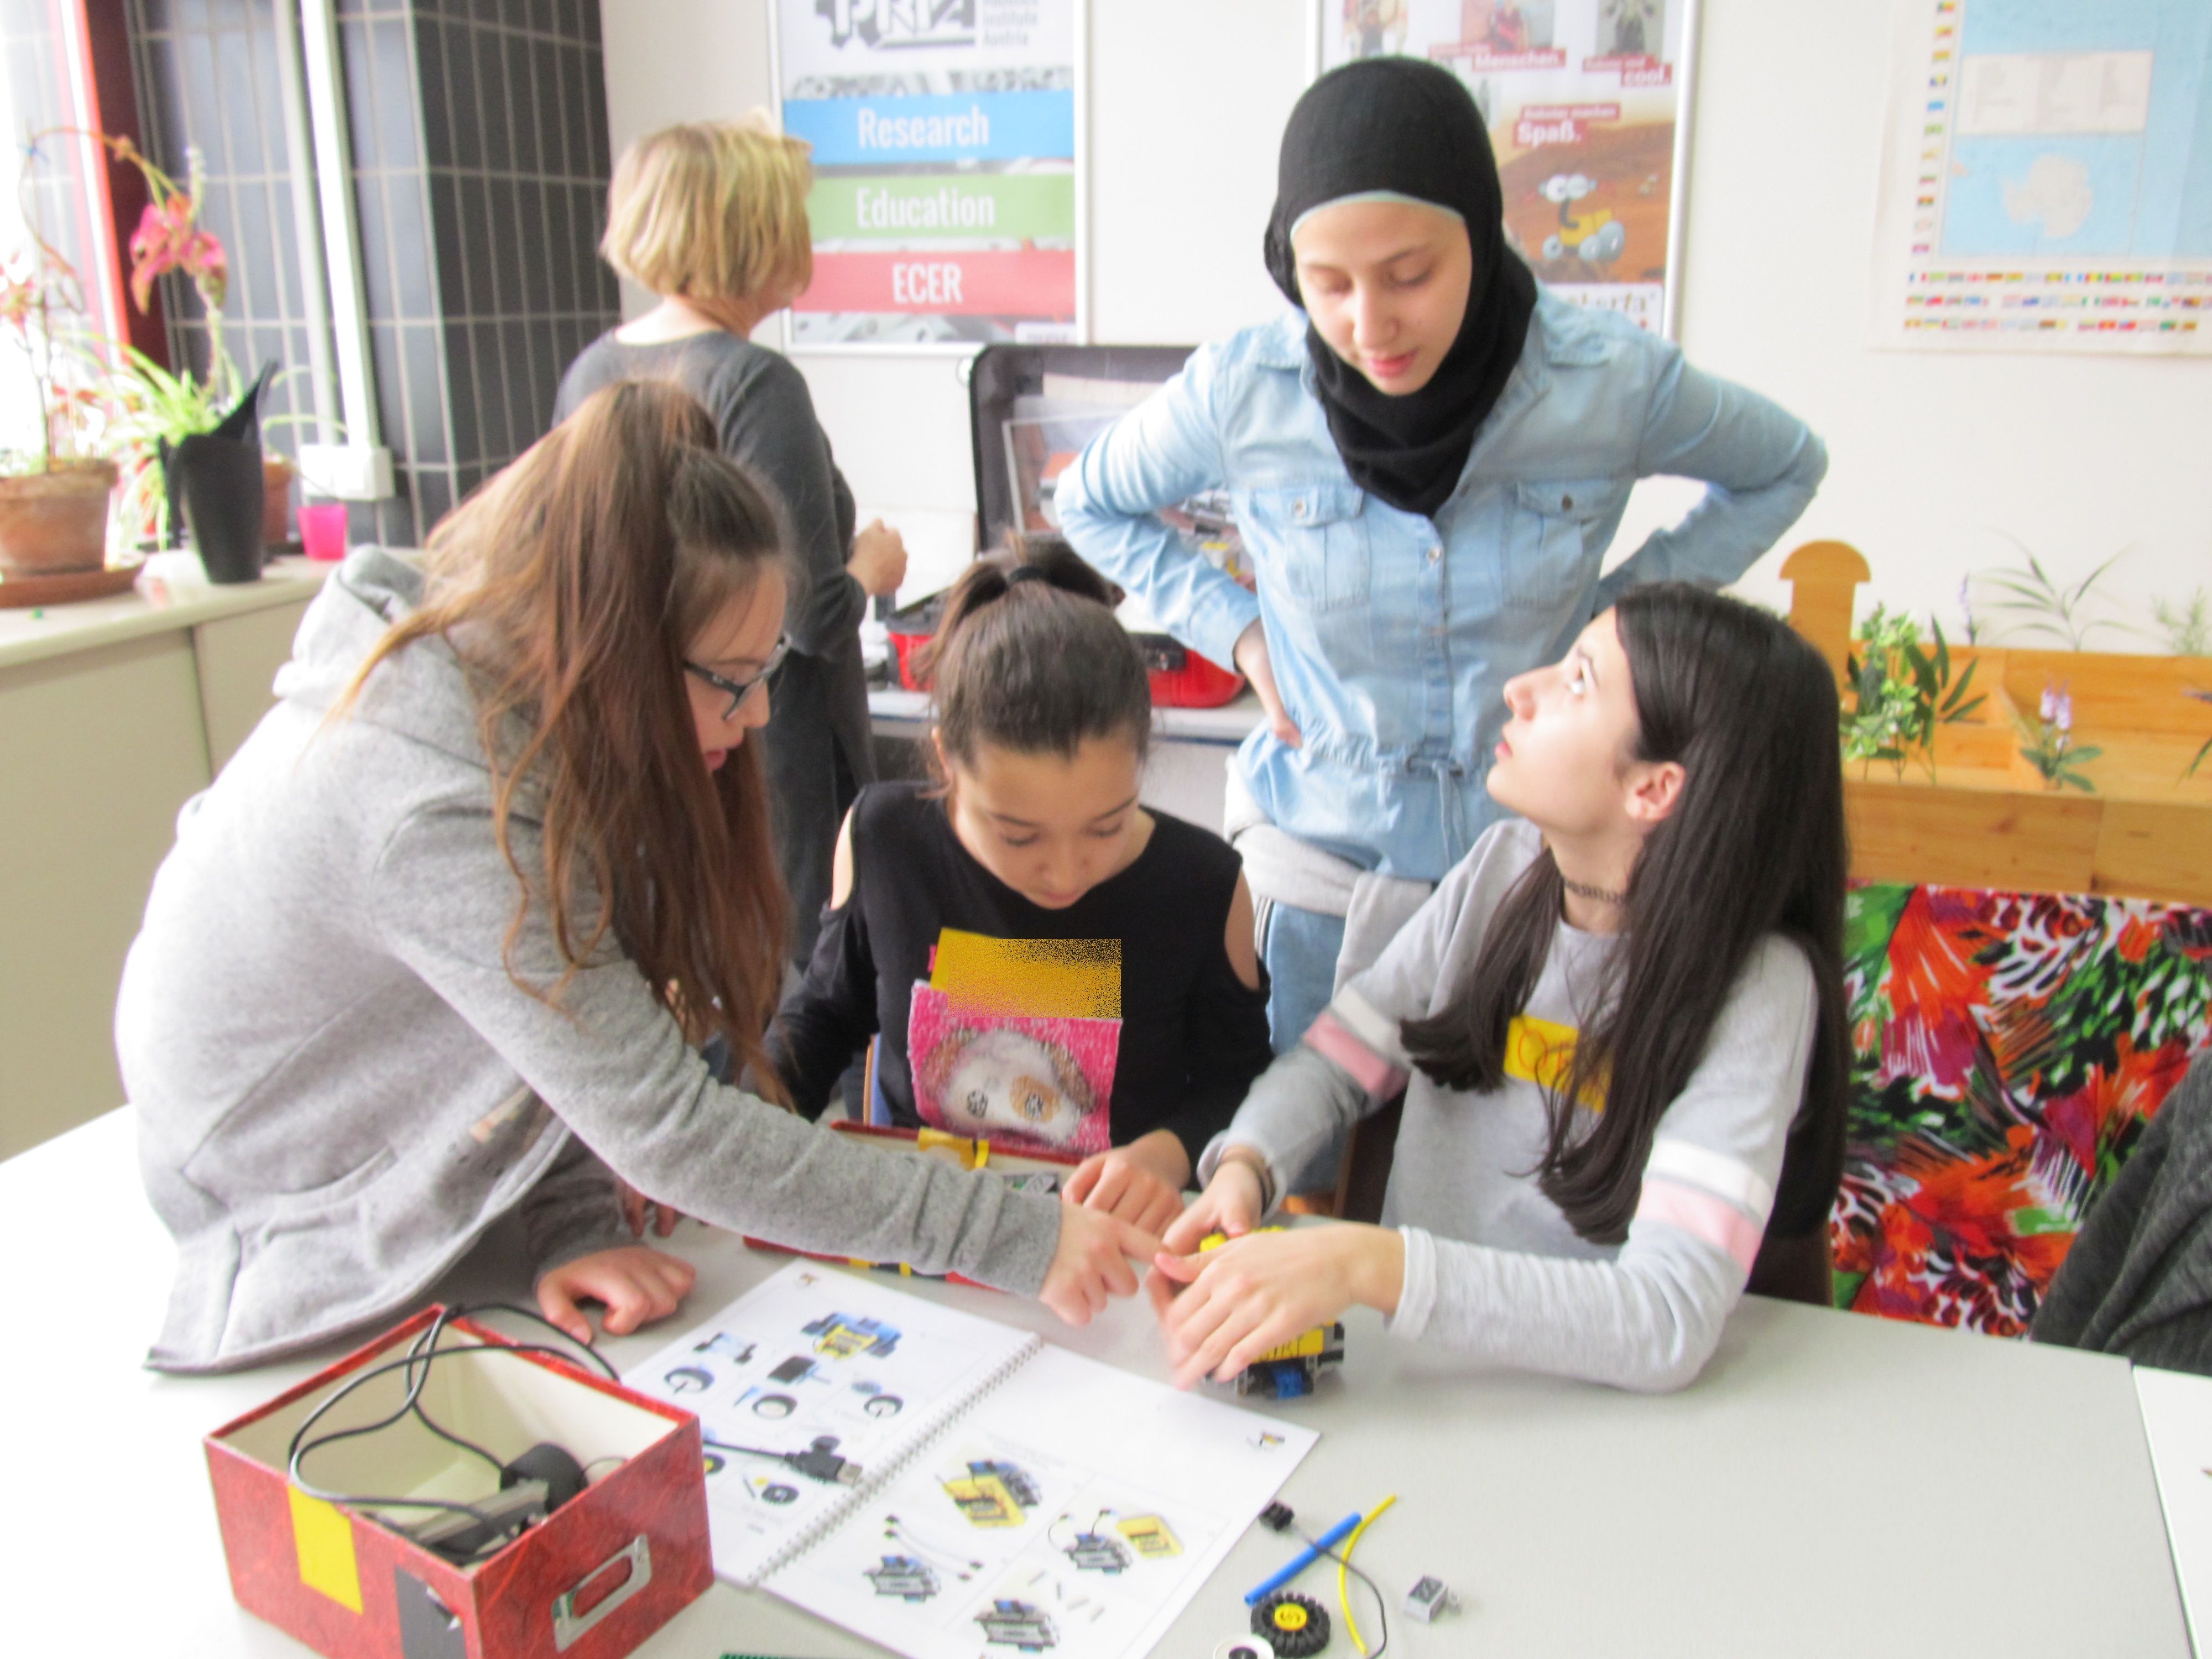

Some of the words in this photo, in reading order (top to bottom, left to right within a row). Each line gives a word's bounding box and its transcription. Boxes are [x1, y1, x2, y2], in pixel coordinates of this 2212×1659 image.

[858, 104, 990, 149] Research
[856, 187, 995, 229] Education
[892, 262, 963, 304] ECER
